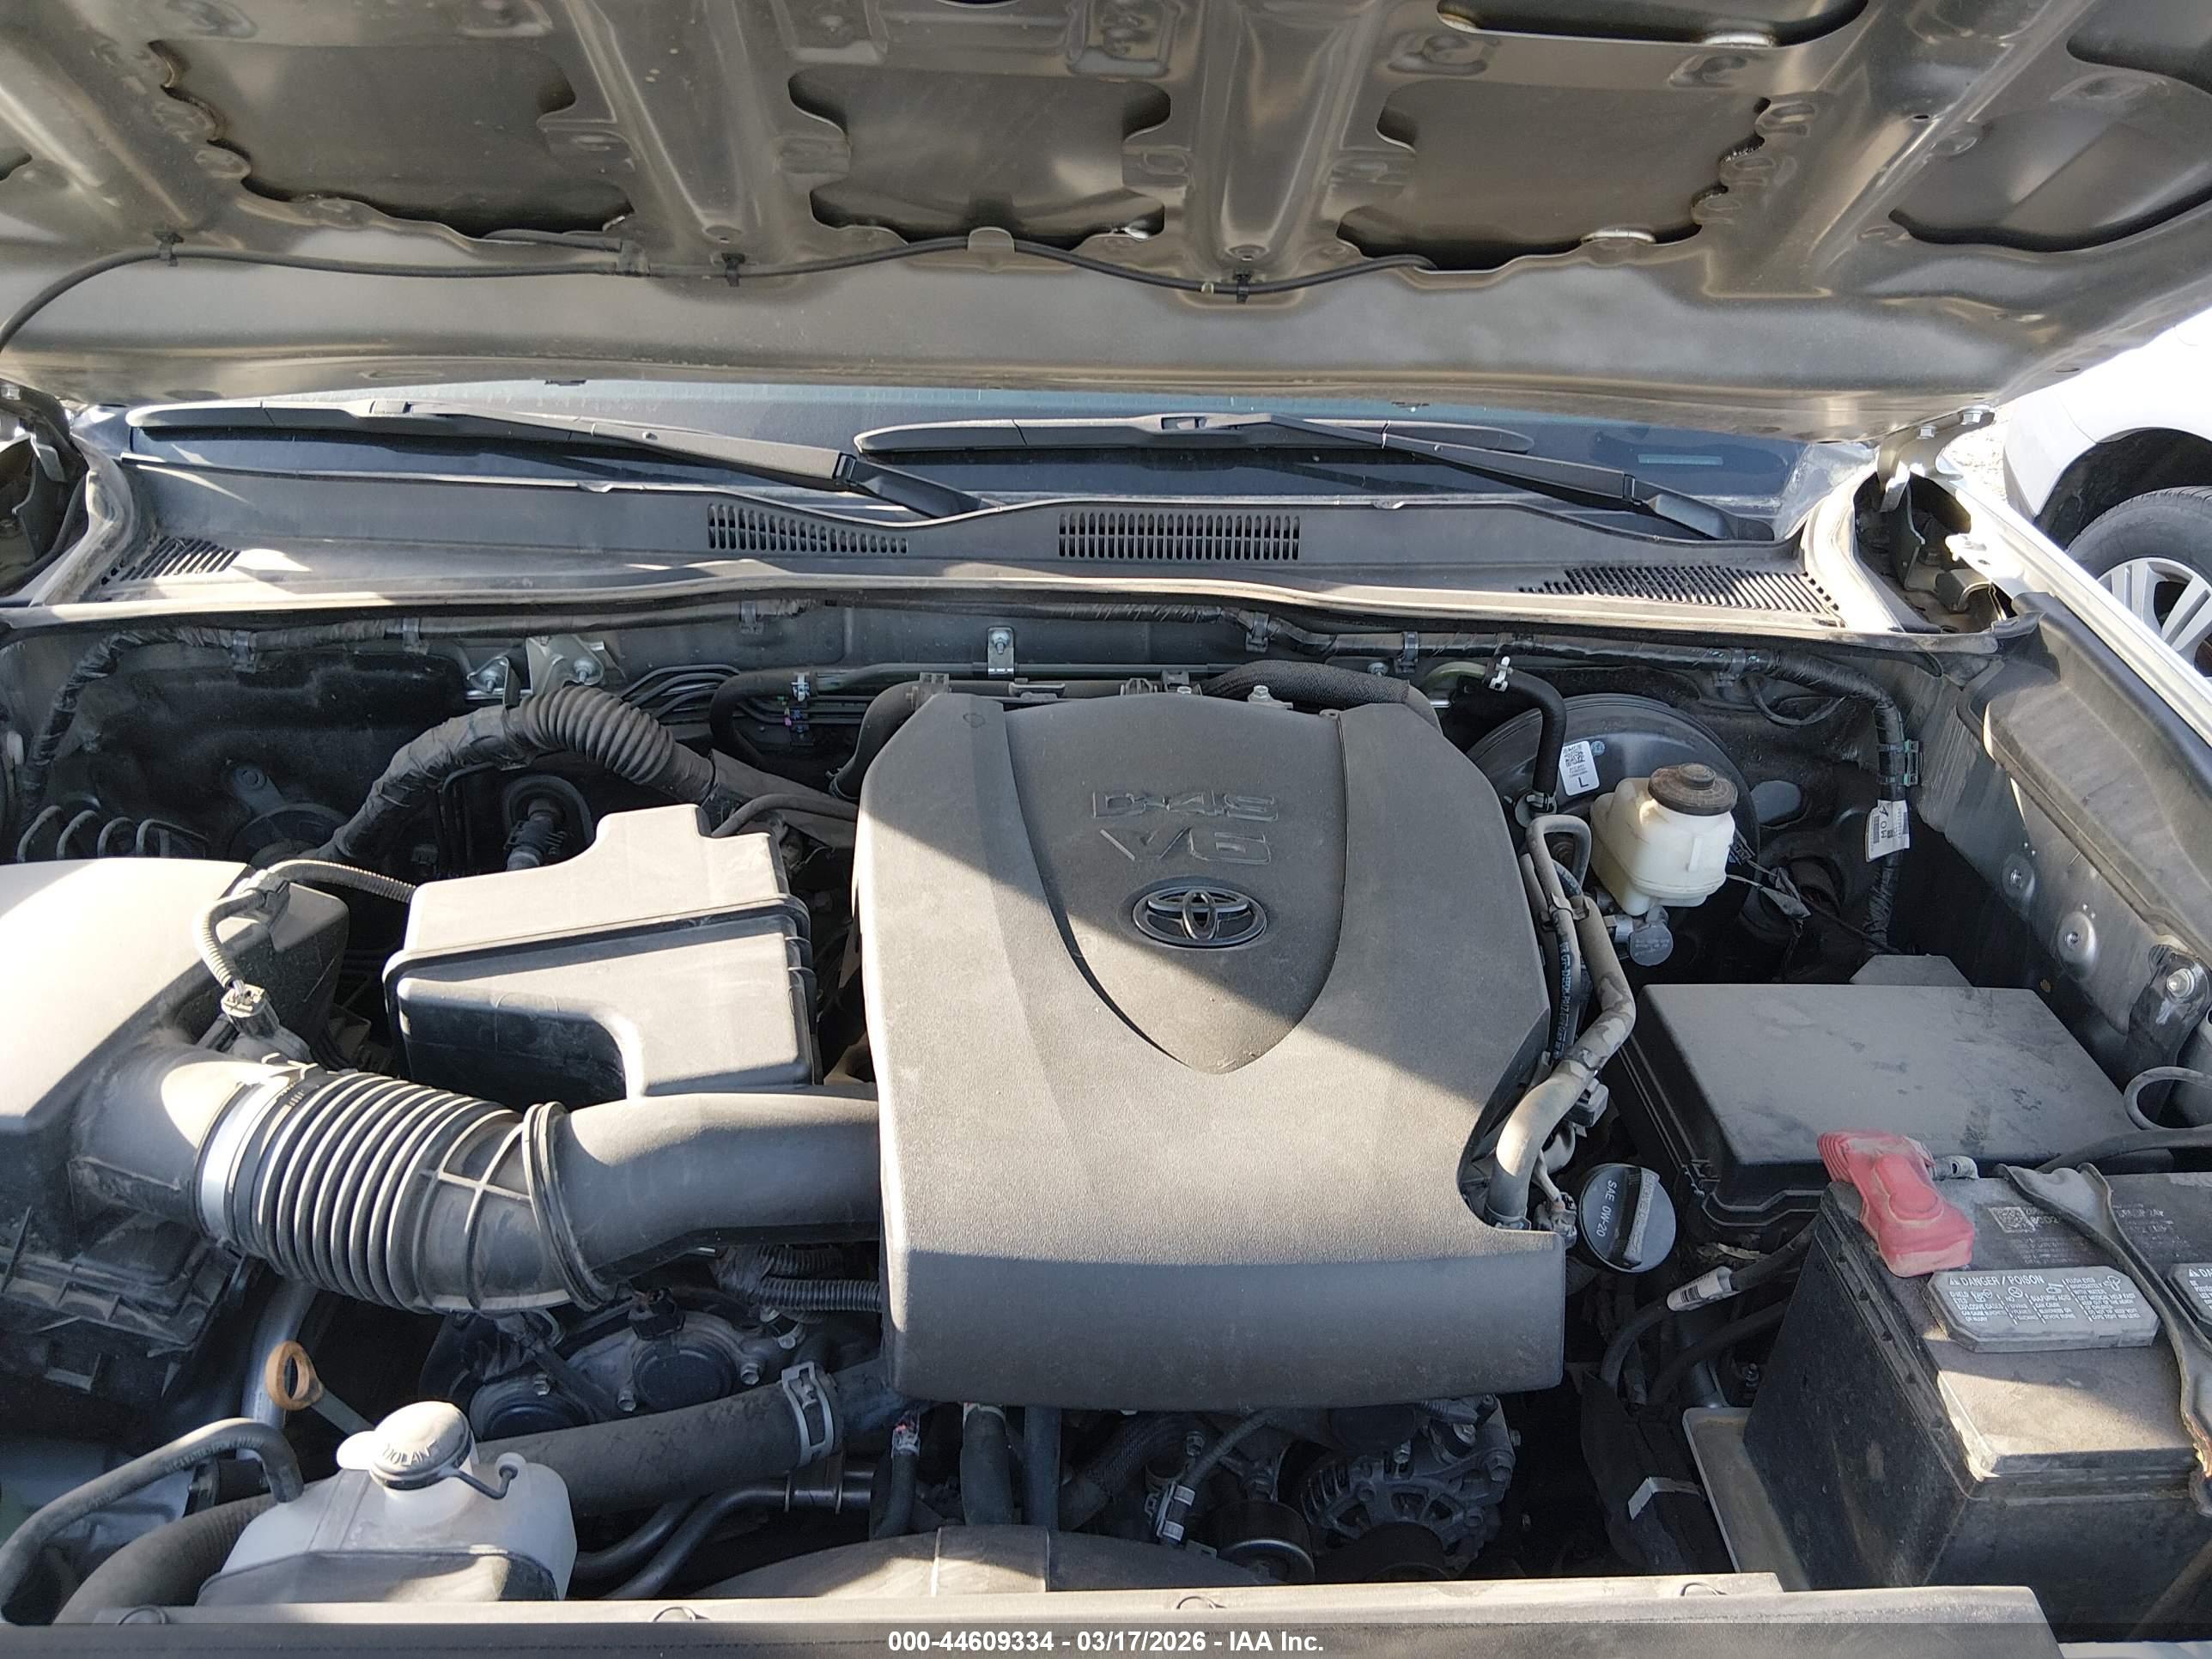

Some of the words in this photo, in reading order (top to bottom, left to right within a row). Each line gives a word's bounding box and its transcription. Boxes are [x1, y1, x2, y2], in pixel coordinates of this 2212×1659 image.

[1577, 777, 1589, 788] L
[1099, 826, 1272, 865] V6
[1605, 1179, 1618, 1202] SAE
[1596, 1206, 1613, 1237] 0W-20
[1960, 1276, 2001, 1286] DANGER
[2007, 1275, 2045, 1285] POISON
[381, 1439, 434, 1466] OOLANT
